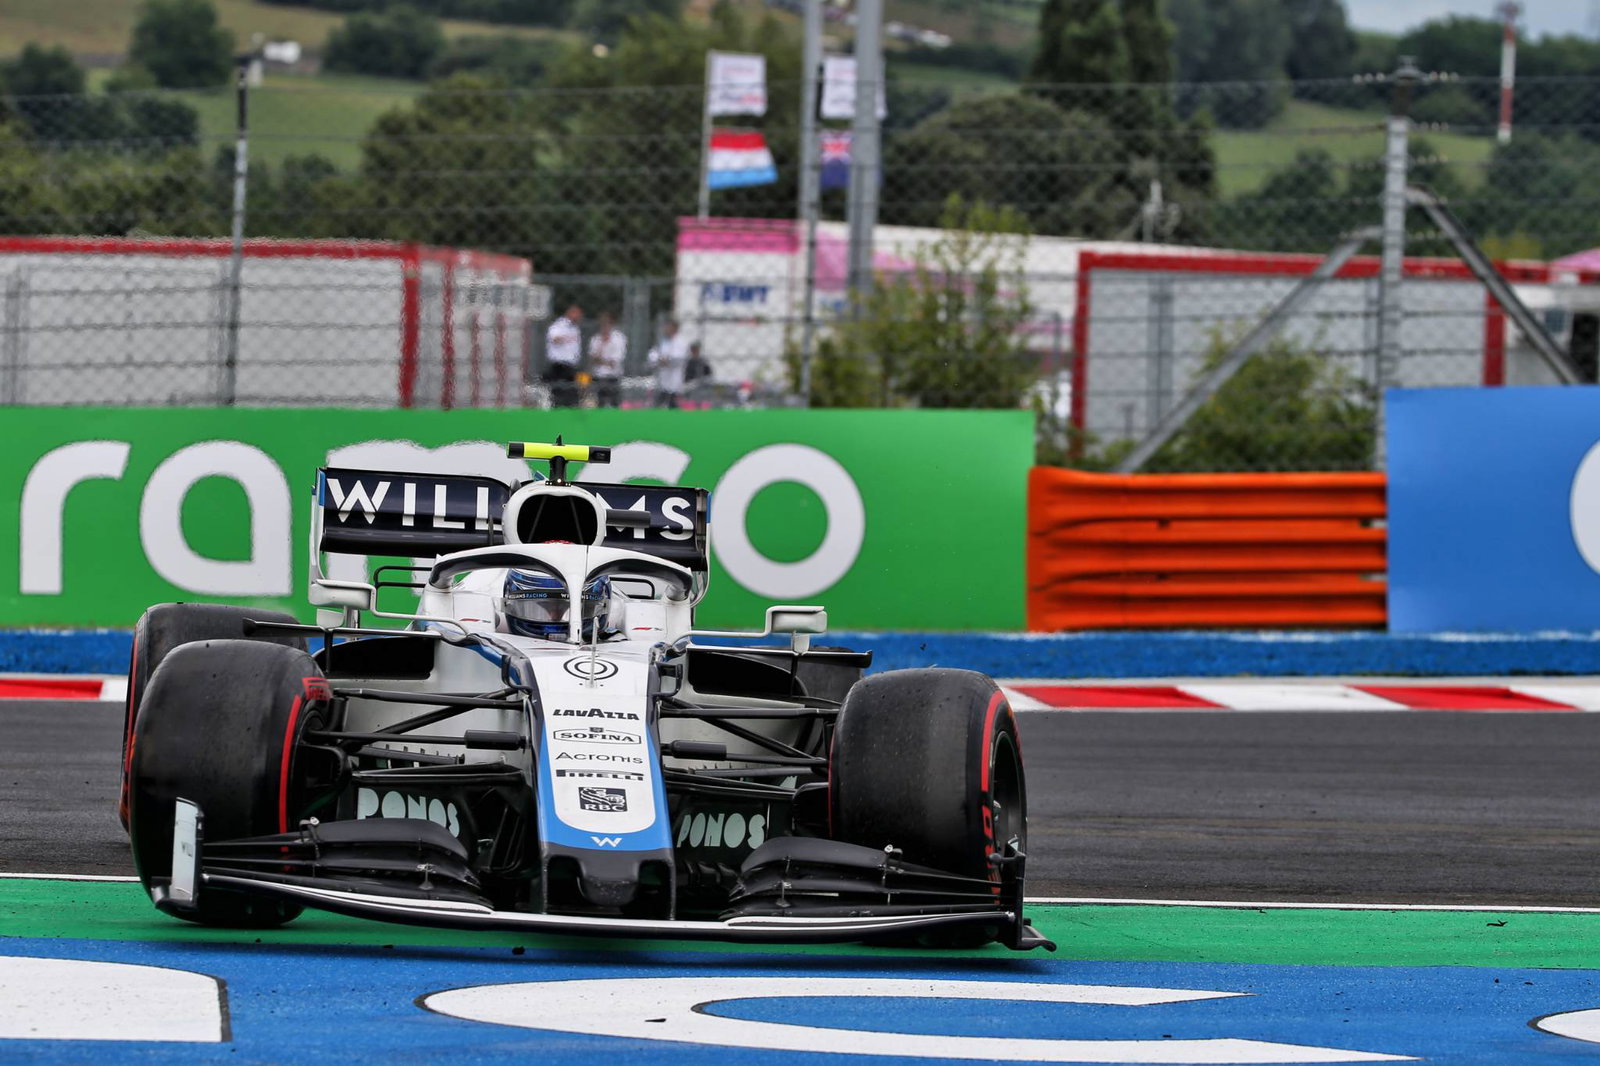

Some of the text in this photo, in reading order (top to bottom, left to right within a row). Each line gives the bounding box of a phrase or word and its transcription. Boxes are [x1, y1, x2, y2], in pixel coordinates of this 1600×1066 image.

[19, 440, 866, 598] rao
[326, 478, 695, 541] WILLMS
[552, 707, 640, 721] LAVAZZA
[560, 732, 635, 743] SOFINA
[555, 769, 645, 782] PIRELLI
[356, 787, 460, 838] PONOS
[584, 803, 626, 812] RBC
[676, 812, 766, 850] PONOS
